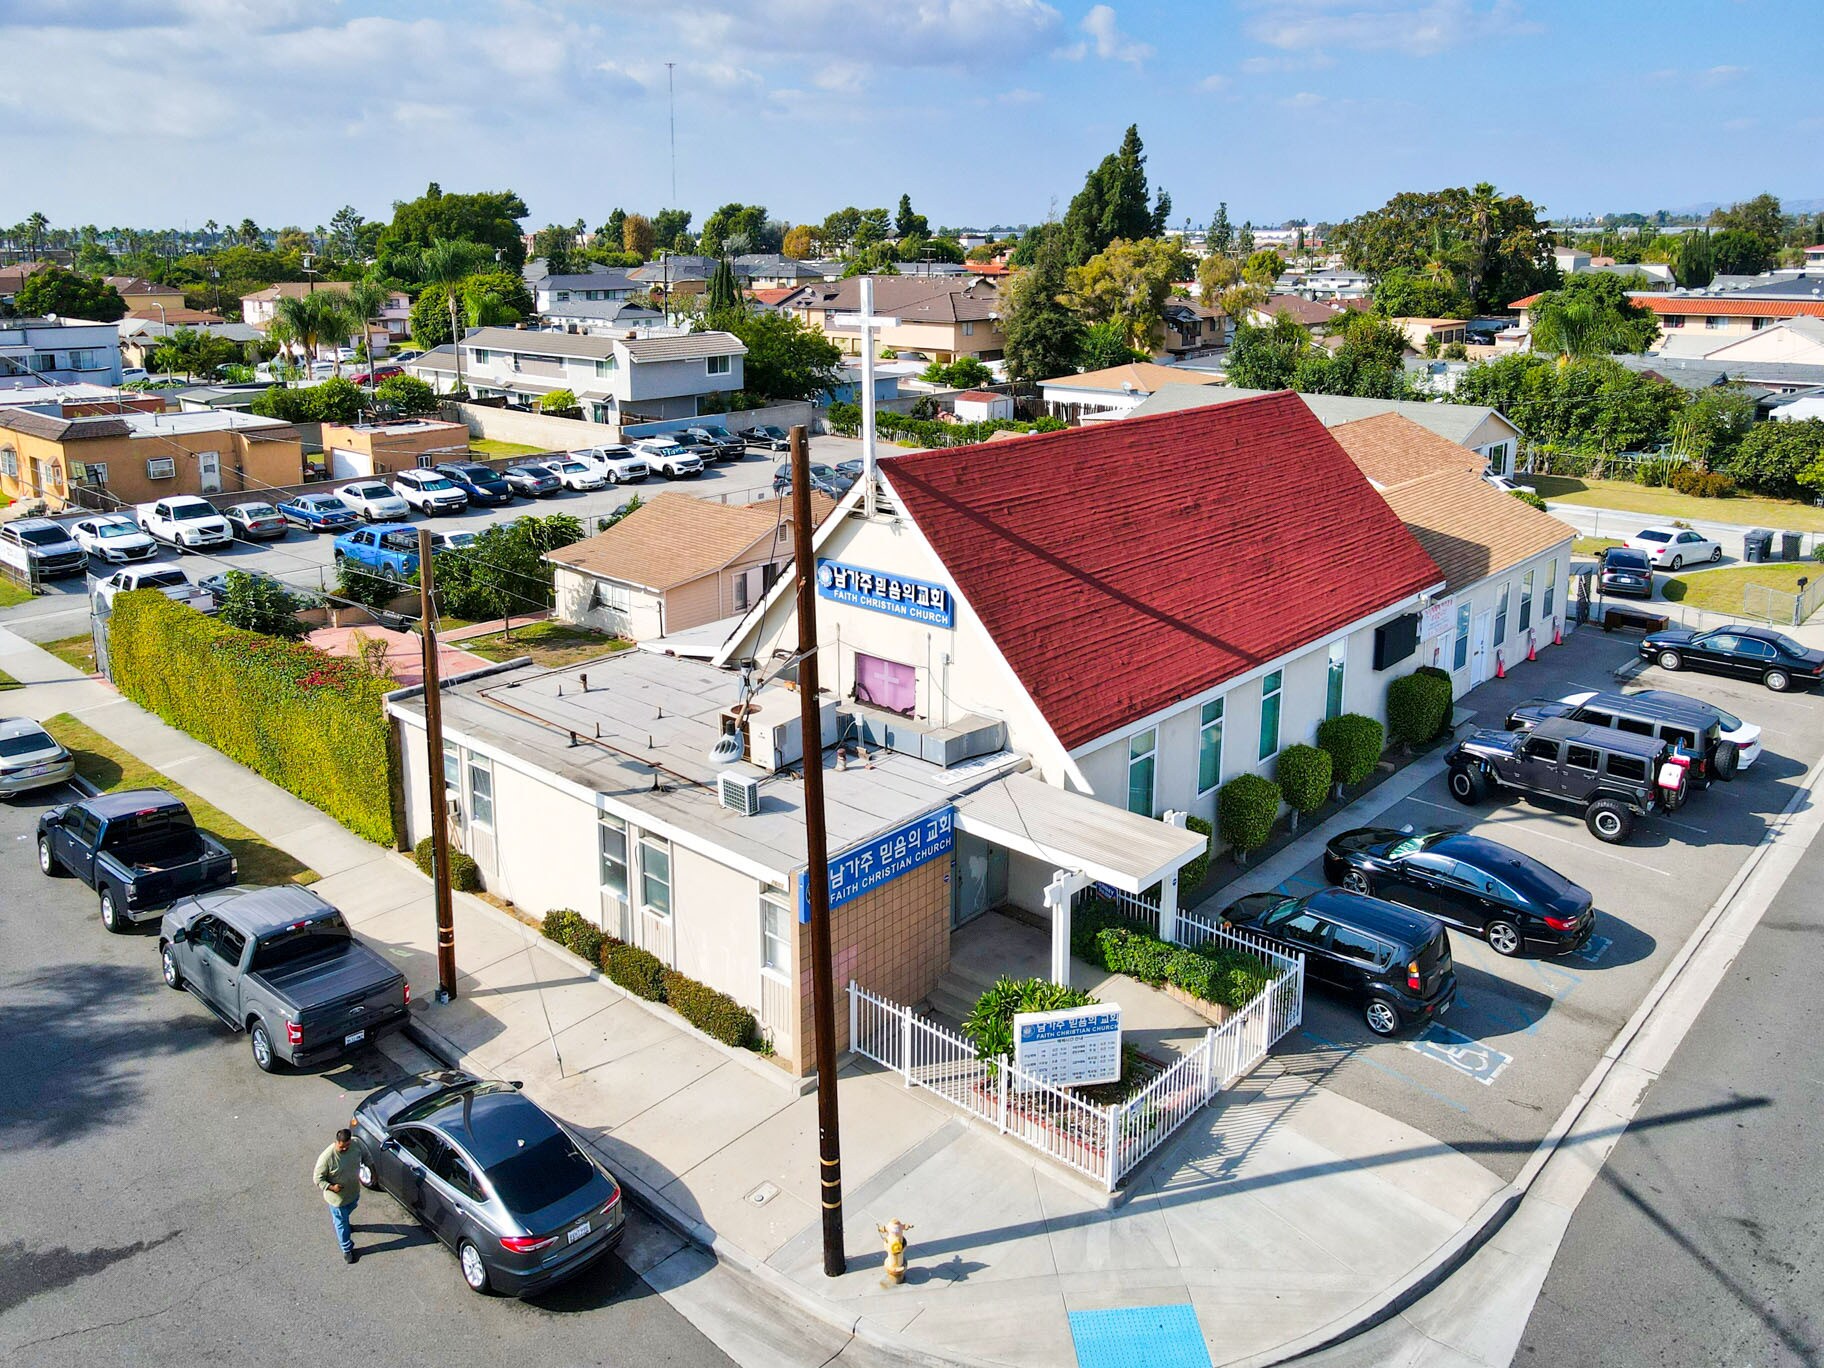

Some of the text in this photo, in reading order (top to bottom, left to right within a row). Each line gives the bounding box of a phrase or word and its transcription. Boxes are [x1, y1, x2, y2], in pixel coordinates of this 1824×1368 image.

[834, 567, 873, 595] 남가주
[834, 590, 948, 625] FAITH CHRISTIAN CHURCH
[829, 813, 952, 889] 남가주 믿음의 교회
[830, 837, 952, 904] FAITH CHRISTIAN CHURCH
[1036, 1024, 1118, 1040] FAITH CHRISTIAN CHURCH
